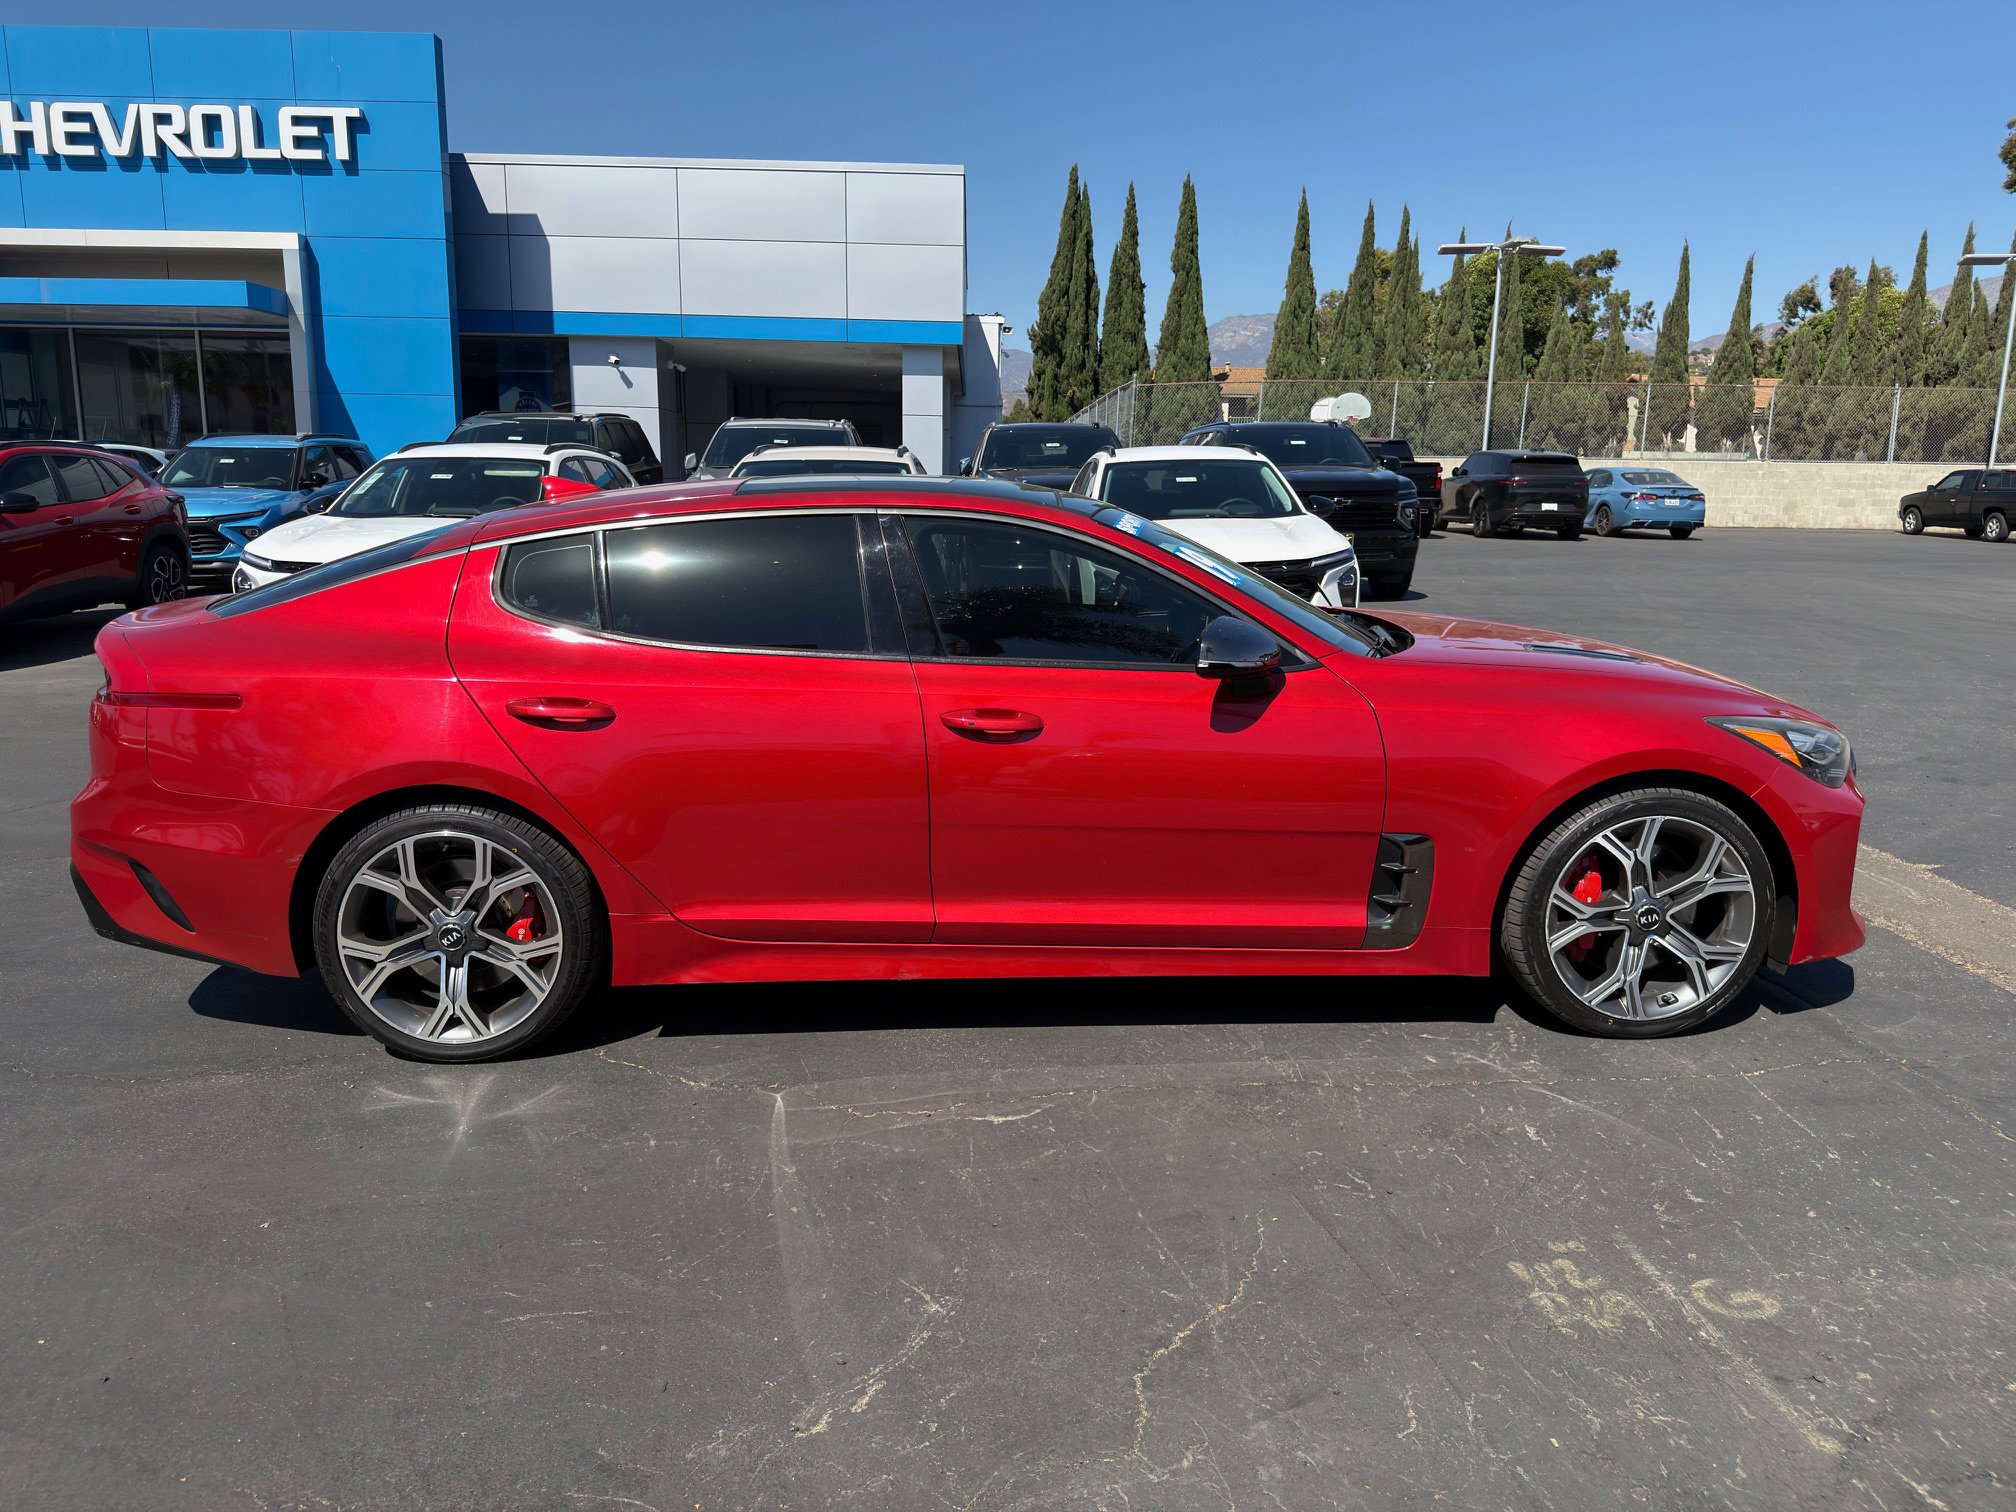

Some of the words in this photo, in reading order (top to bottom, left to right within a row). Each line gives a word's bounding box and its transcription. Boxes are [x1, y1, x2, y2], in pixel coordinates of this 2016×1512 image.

[0, 100, 361, 161] HEVROLET
[1640, 913, 1659, 924] KIA
[441, 931, 461, 946] KIA
